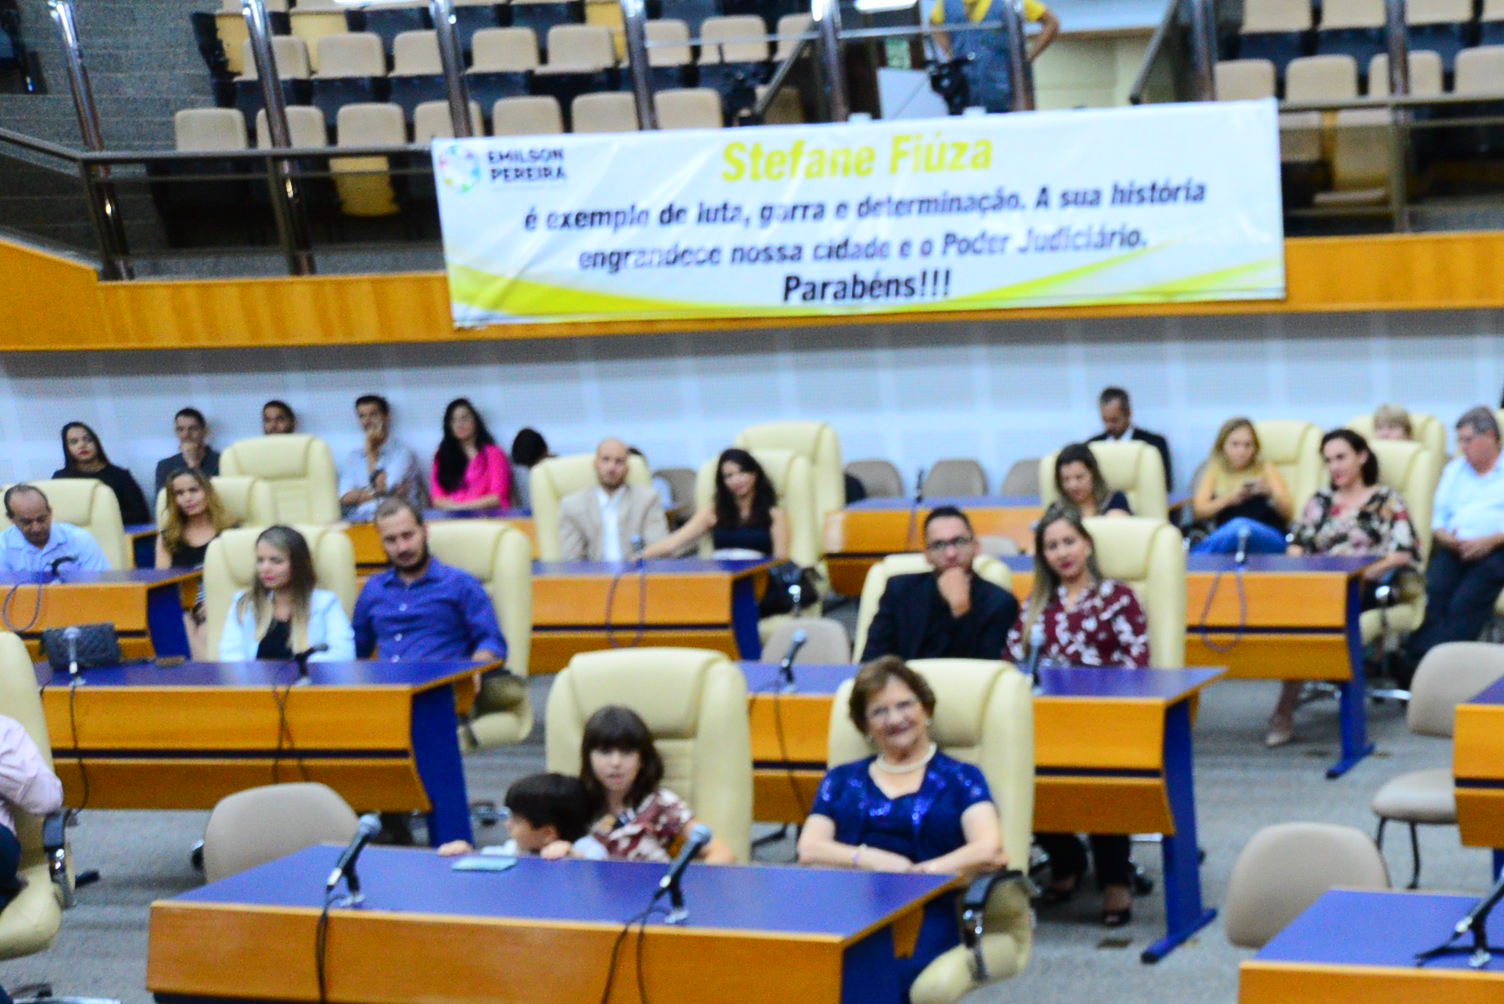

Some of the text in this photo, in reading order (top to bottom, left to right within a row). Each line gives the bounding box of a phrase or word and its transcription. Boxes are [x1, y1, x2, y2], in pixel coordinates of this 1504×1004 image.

[487, 147, 565, 165] EMILSON
[490, 166, 567, 183] PEREIRA
[722, 131, 993, 182] Stefane Fiúza
[524, 176, 1207, 233] é exemplo de luta, garra e determinação. A sua história
[578, 223, 1147, 275] engrandece nossa cidade e o Poder Judiciário.
[783, 269, 952, 302] Parabéns!!!
